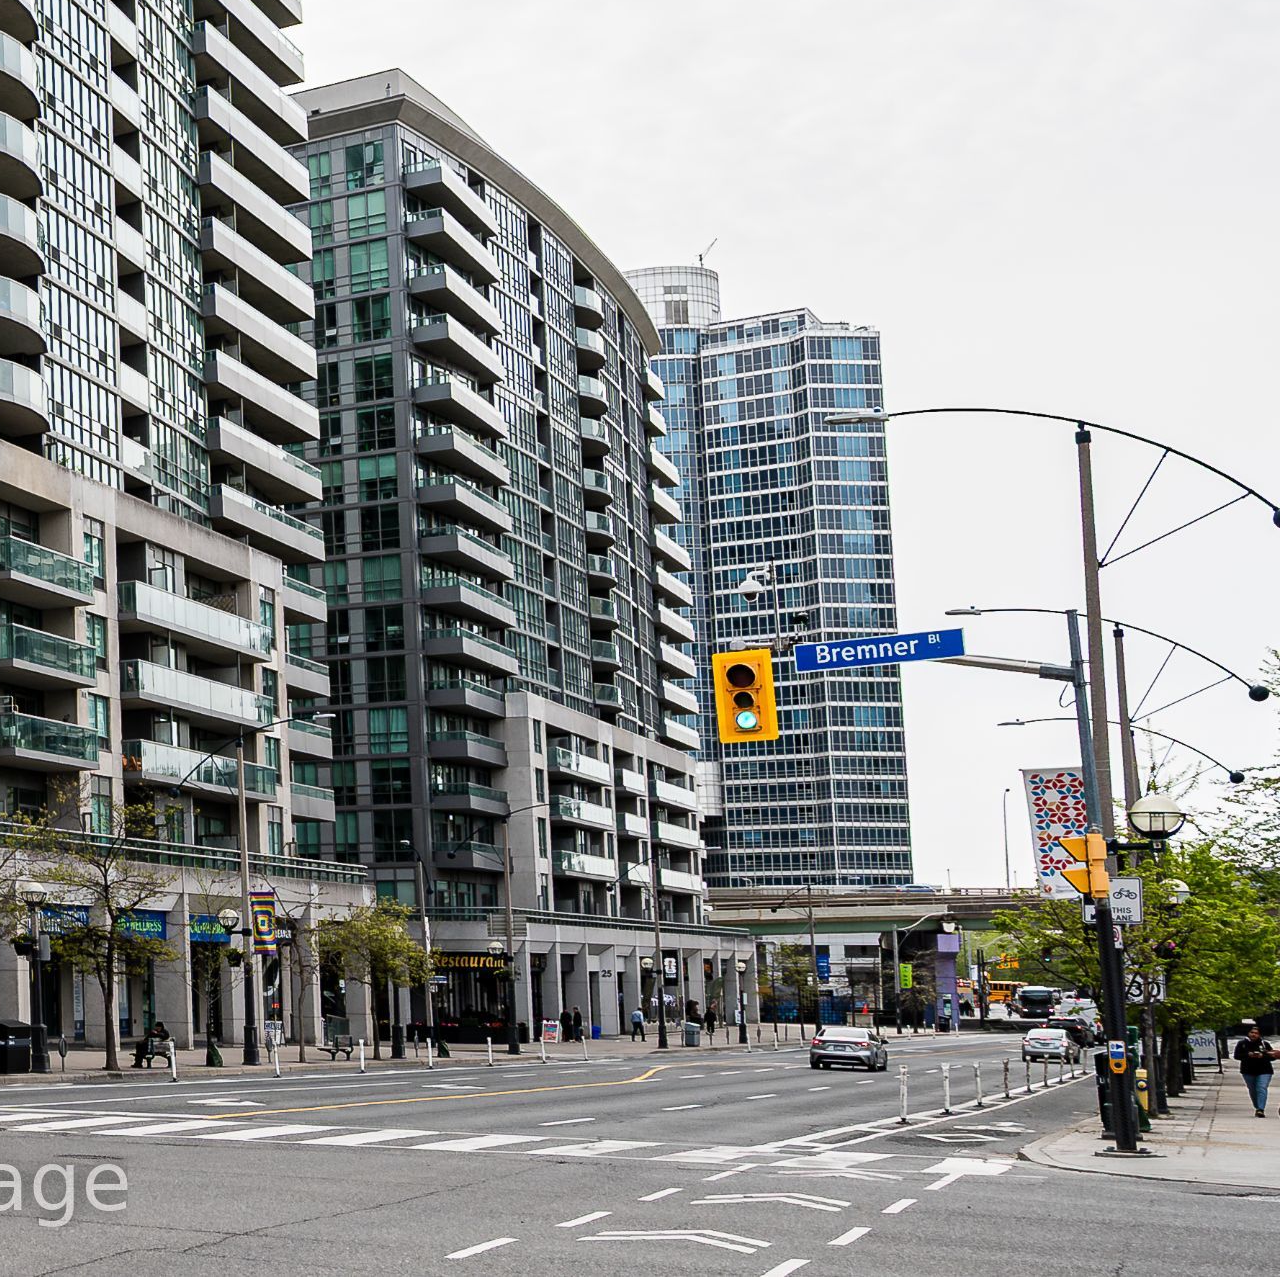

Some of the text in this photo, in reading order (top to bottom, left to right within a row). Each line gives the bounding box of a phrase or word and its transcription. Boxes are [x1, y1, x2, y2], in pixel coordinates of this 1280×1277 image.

[816, 639, 919, 664] Bremner
[1111, 906, 1132, 914] THIS
[601, 969, 612, 978] 25
[1187, 1037, 1216, 1047] PARK
